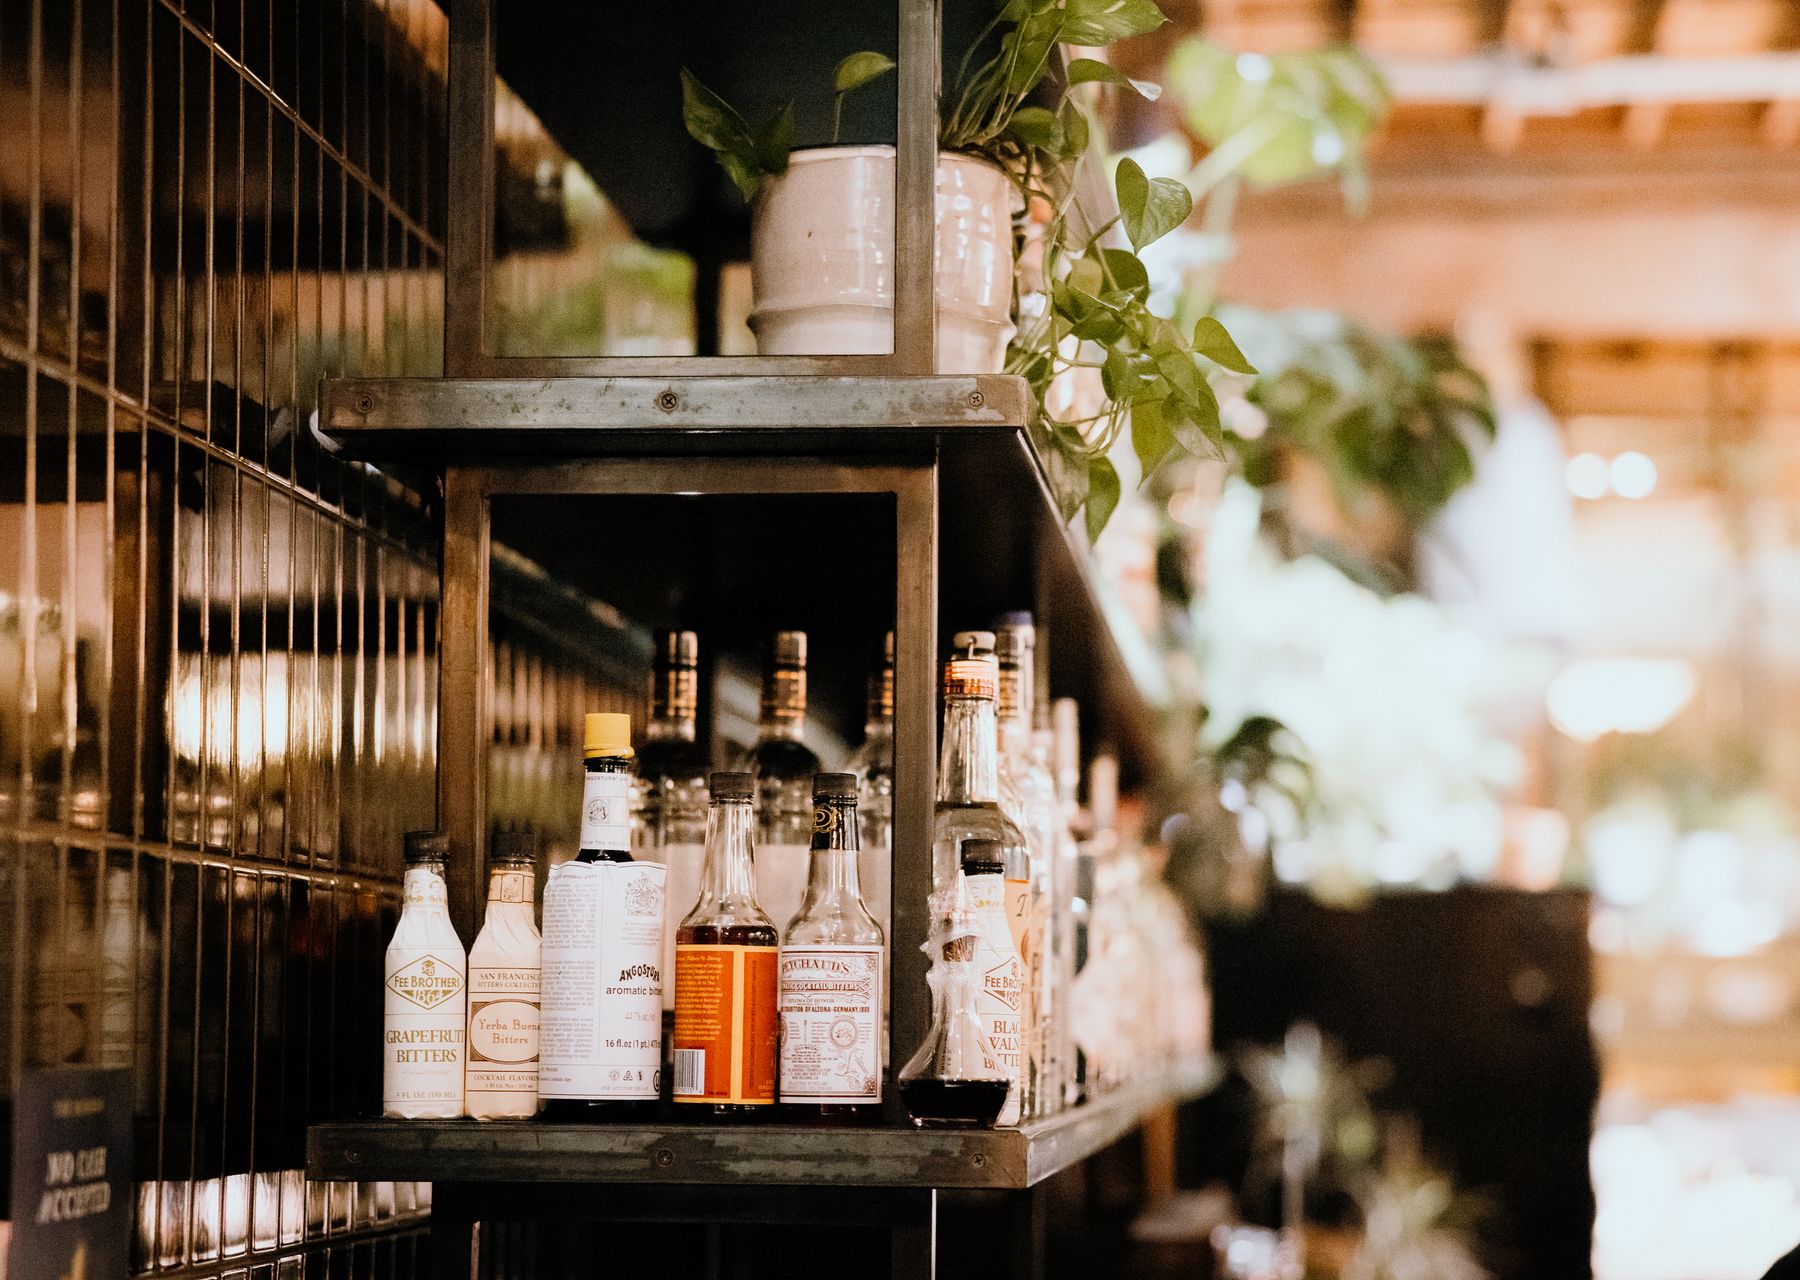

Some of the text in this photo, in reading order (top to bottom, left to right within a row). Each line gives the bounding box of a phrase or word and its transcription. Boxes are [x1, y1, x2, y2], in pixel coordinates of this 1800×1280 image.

[394, 975, 409, 988] FEE
[480, 972, 496, 980] SAN
[985, 976, 1001, 988] FEE
[606, 986, 648, 995] aromatic
[479, 1018, 507, 1030] Yerba
[385, 1029, 464, 1044] GRAPEFRUIT
[492, 1032, 529, 1044] Bitters
[605, 1039, 614, 1048] 16
[396, 1048, 457, 1063] BITTERS
[508, 1074, 539, 1082] FLAVORIN
[413, 1091, 426, 1099] OZ
[45, 1150, 75, 1187] NO
